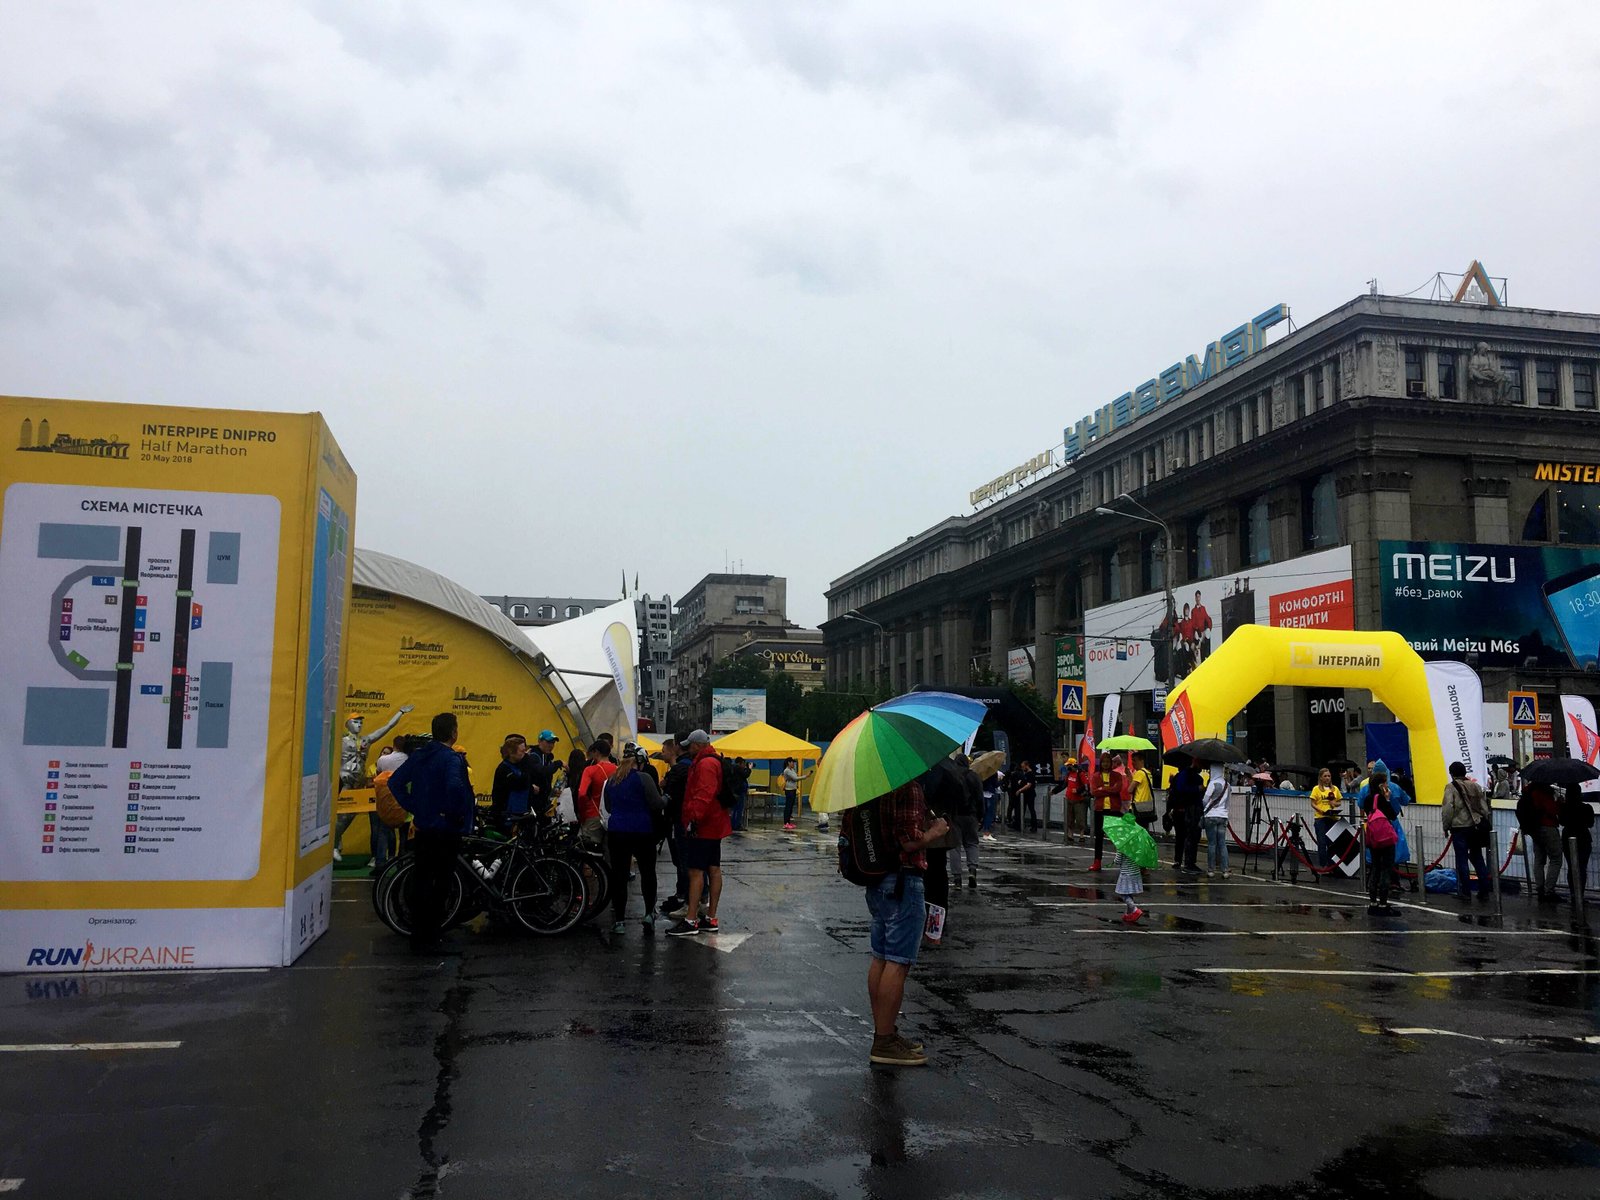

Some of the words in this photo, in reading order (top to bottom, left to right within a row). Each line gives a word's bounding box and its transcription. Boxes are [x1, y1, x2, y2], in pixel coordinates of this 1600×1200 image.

[142, 424, 218, 439] INTERPIPE
[223, 428, 276, 442] DNIPRO
[141, 440, 172, 452] Half
[177, 442, 247, 456] Marathon
[153, 454, 170, 464] May
[81, 500, 129, 512] СХЕМА
[133, 502, 203, 516] МІСТЕЧКА
[1392, 552, 1516, 583] MEIZU
[1395, 586, 1463, 600] #без_рамок
[1280, 590, 1344, 613] КОМФОРТНІ
[1569, 590, 1600, 614] 18:30
[1280, 611, 1329, 628] КРЕДИТИ
[1089, 644, 1140, 662] ФОКСОТ
[1408, 638, 1438, 651] овий
[1443, 638, 1486, 652] Meizu
[1490, 640, 1520, 654] M6s
[1057, 654, 1074, 666] ЗБРОЯ
[1318, 655, 1380, 667] ІНТЕРПАЙП
[88, 917, 136, 925] Організатор:
[27, 948, 84, 966] RUN
[90, 946, 195, 965] UKRAINE
